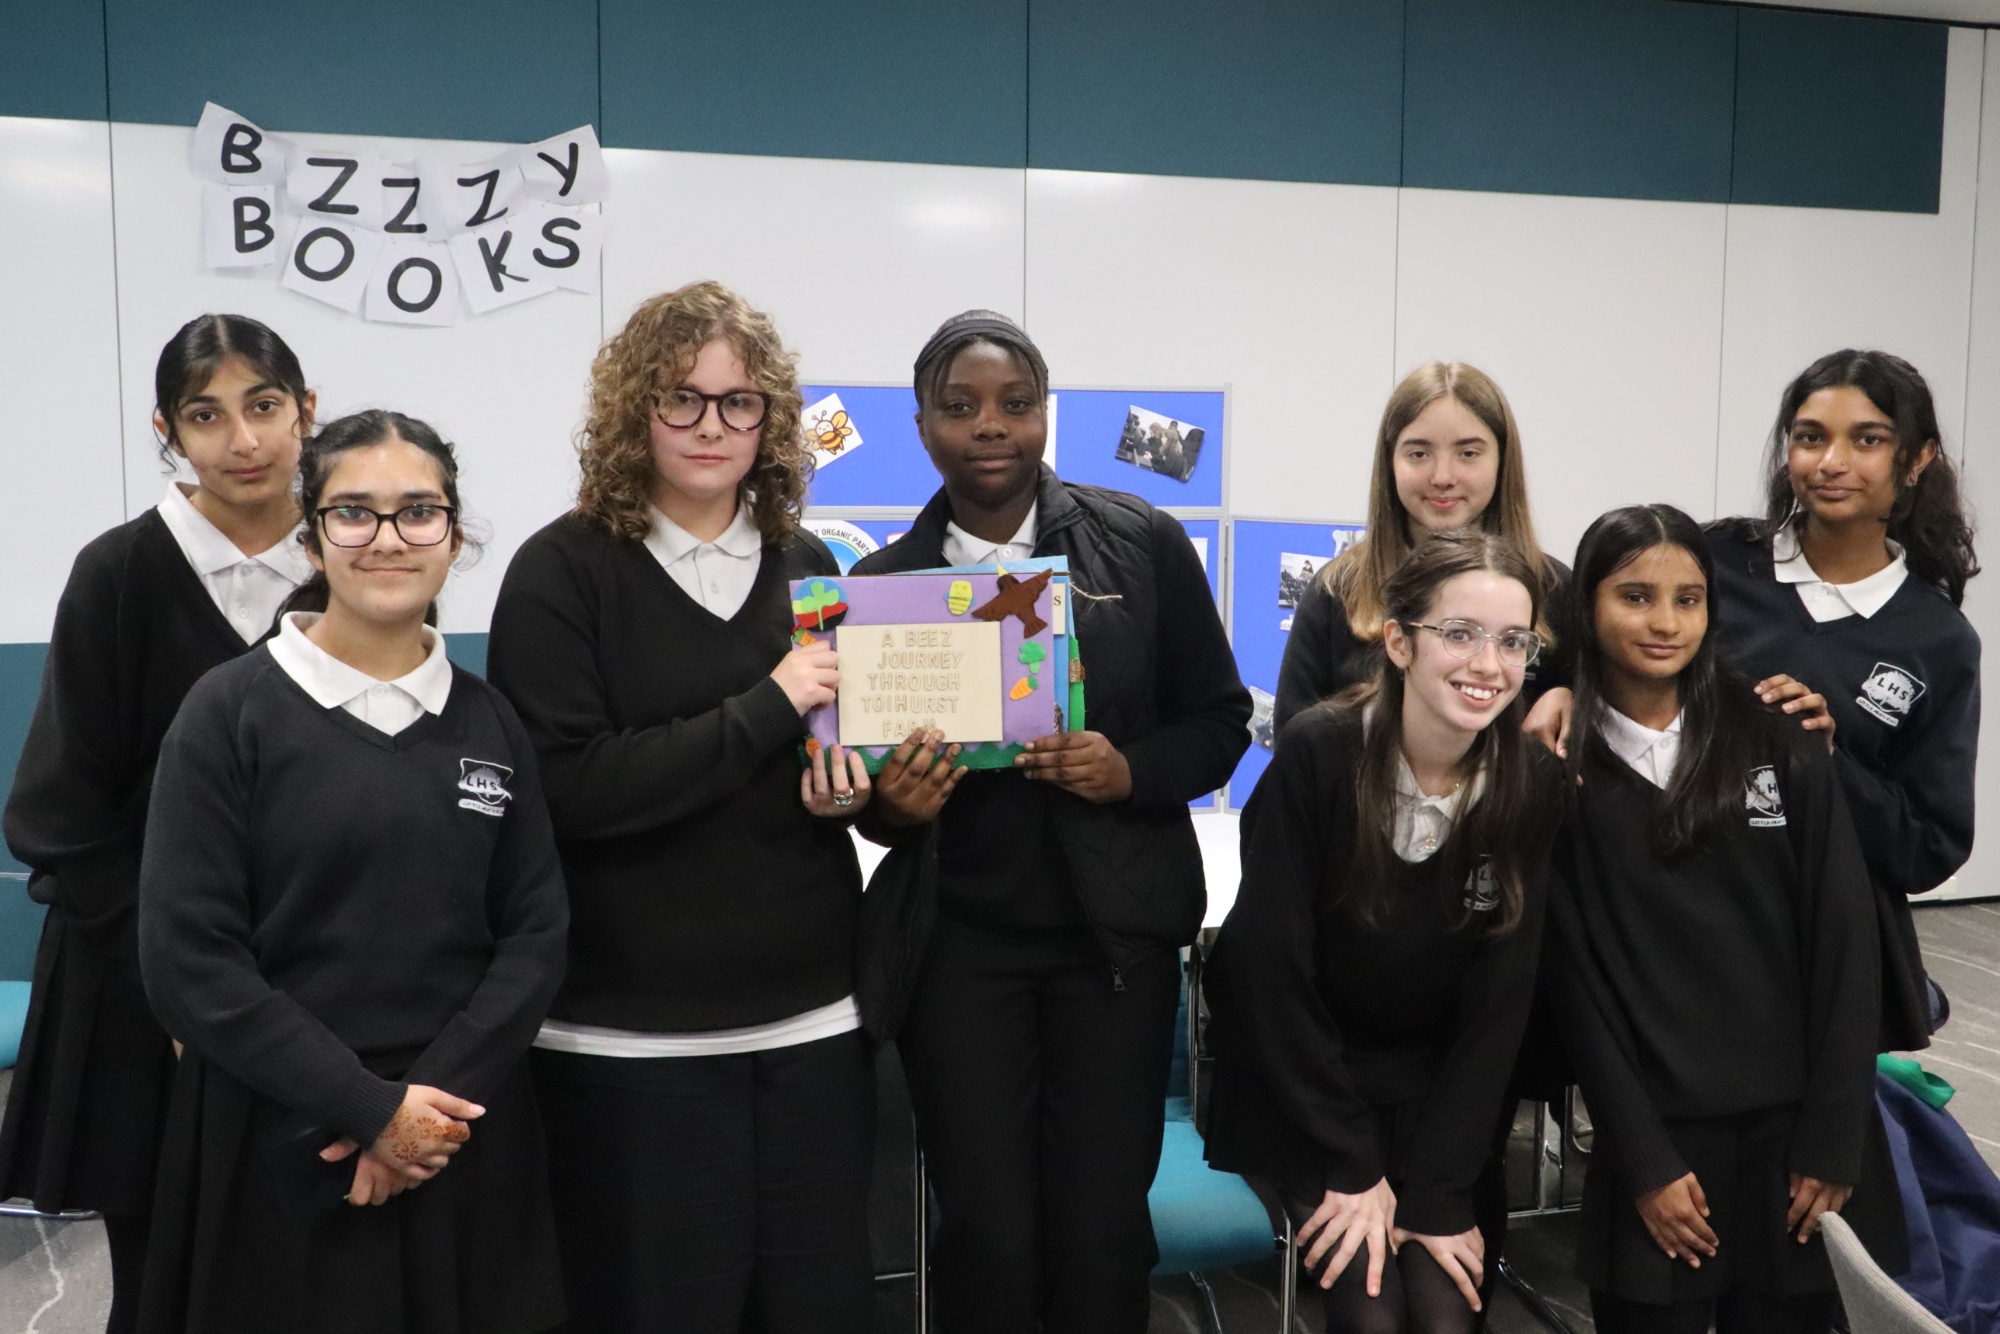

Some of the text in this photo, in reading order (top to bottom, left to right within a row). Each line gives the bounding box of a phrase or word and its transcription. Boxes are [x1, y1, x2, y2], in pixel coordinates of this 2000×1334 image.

[220, 122, 579, 234] BZZZY
[232, 196, 582, 313] BOOKS
[821, 528, 852, 541] ORGANIC
[881, 629, 952, 648] A BEEZ
[877, 650, 963, 669] JOURNEY
[867, 672, 960, 692] THROUGH
[1877, 677, 1908, 700] LHS
[466, 775, 498, 791] LHS
